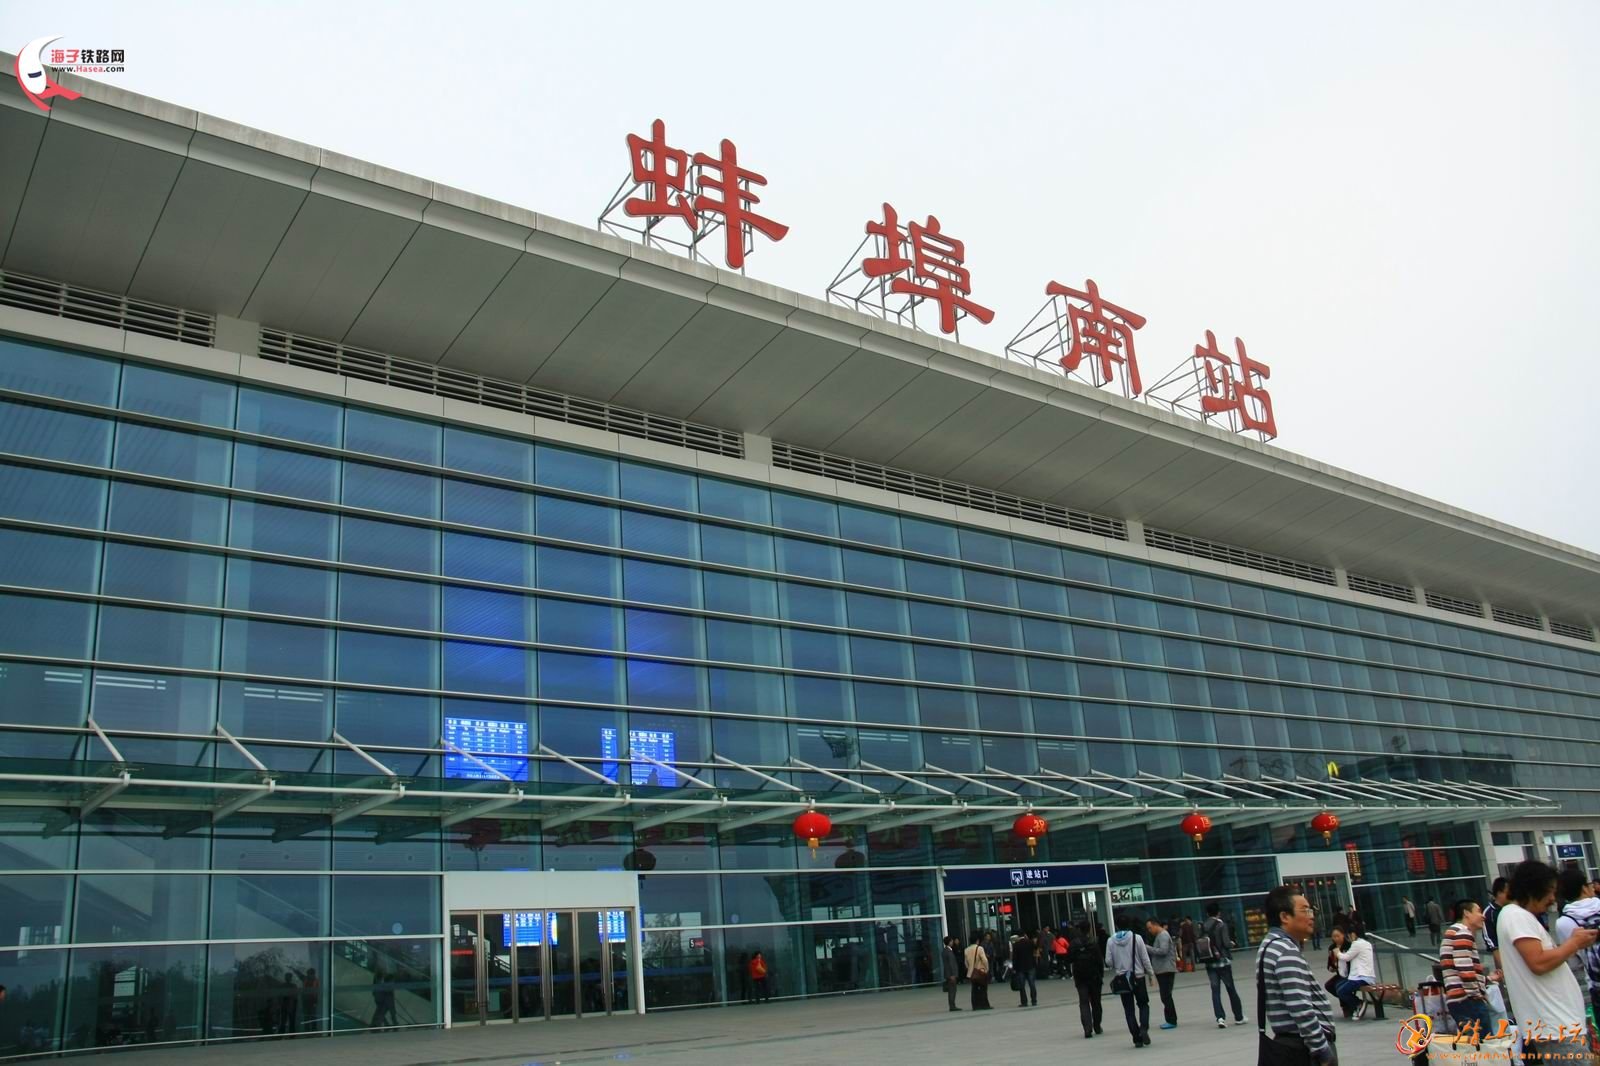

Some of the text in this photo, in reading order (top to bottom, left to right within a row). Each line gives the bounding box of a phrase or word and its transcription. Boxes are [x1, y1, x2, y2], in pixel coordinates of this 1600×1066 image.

[624, 118, 1278, 441] 蚌埠南站
[1025, 869, 1049, 879] 进站口
